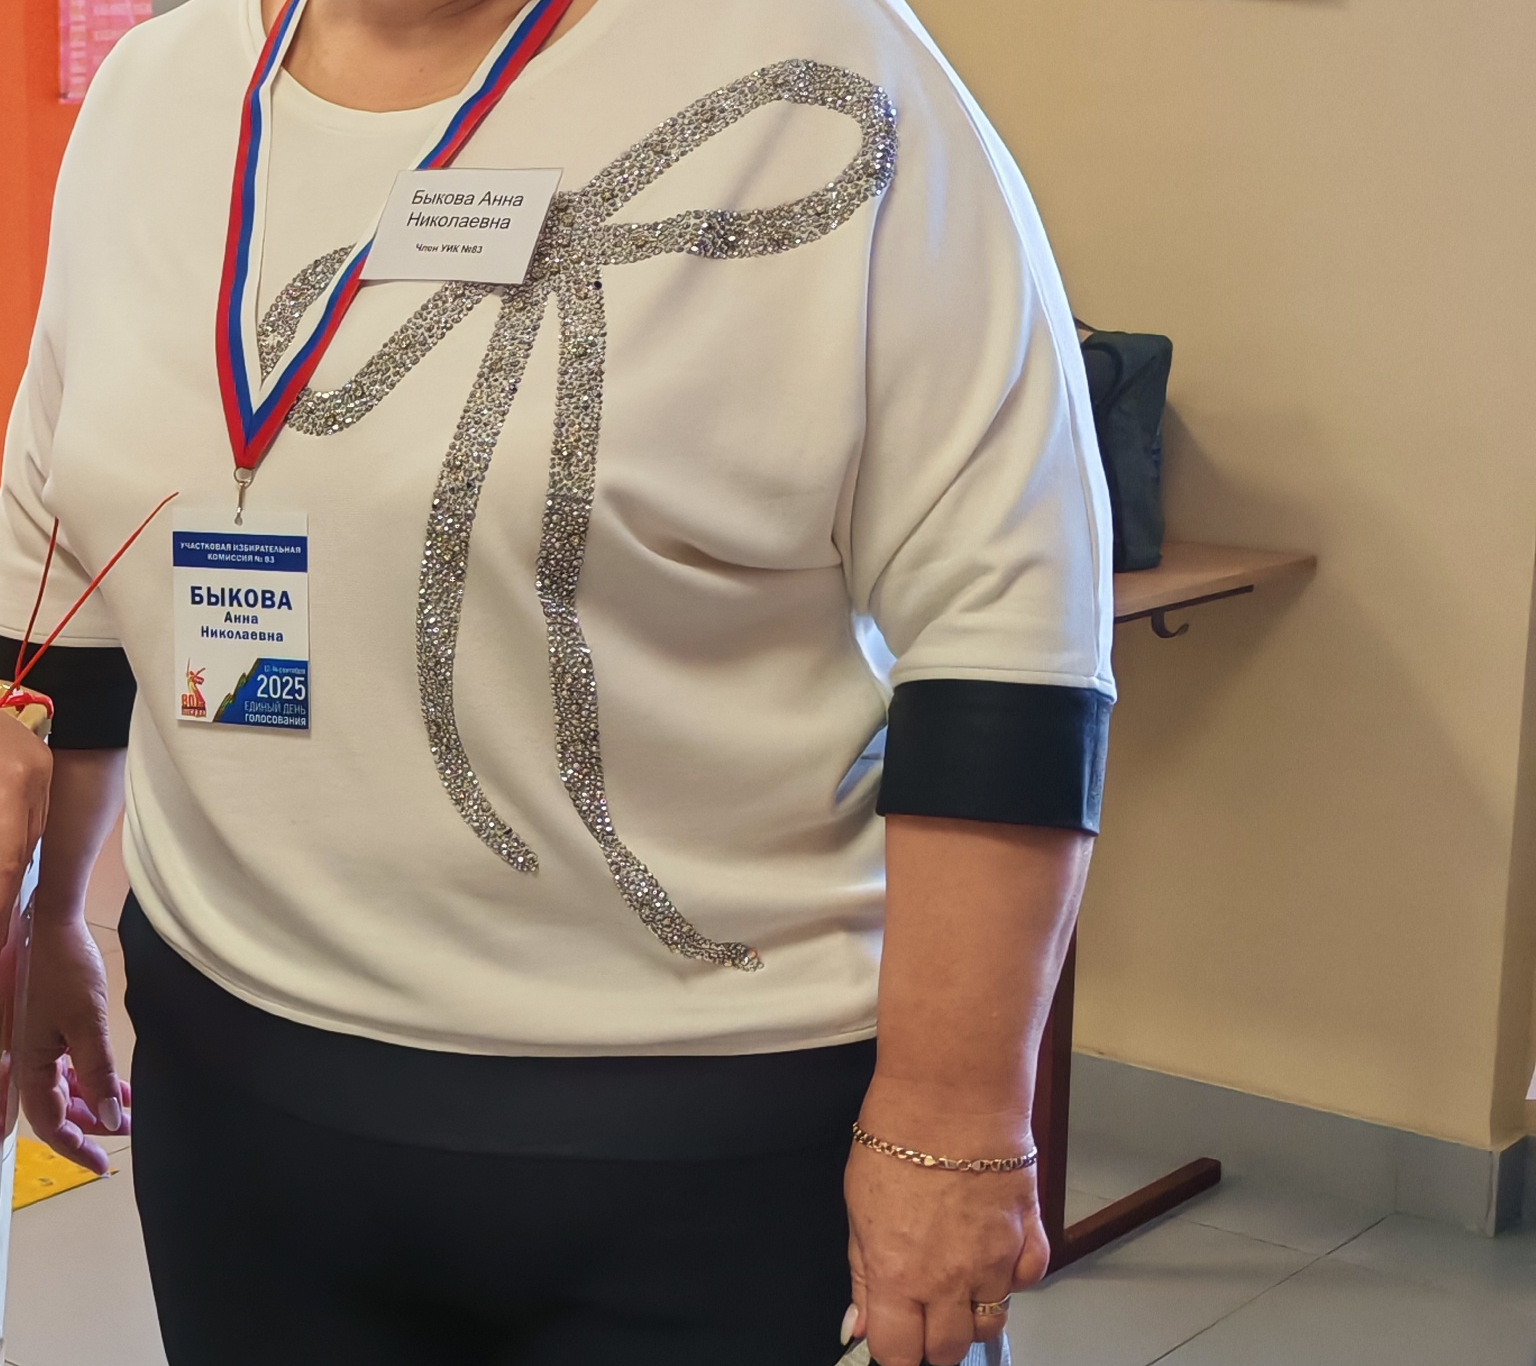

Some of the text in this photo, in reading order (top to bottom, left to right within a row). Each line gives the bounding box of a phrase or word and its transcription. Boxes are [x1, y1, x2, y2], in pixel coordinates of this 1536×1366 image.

[411, 189, 524, 207] Быкова Анна
[406, 211, 511, 230] Николаевна
[415, 243, 438, 253] Член
[440, 244, 460, 253] УИК
[179, 541, 302, 554] УЧАСТКОВАЯ ИЗБИРАТЕЛЬНАЯ
[207, 553, 253, 563] КОМИССИЯ
[190, 585, 293, 611] БЫКОВА
[224, 611, 259, 625] Анна
[200, 625, 284, 642] Николаевна
[257, 674, 306, 700] 2025
[244, 700, 306, 716] ЕДИНЫЙ ДЕНЬ
[245, 713, 307, 726] голосования
